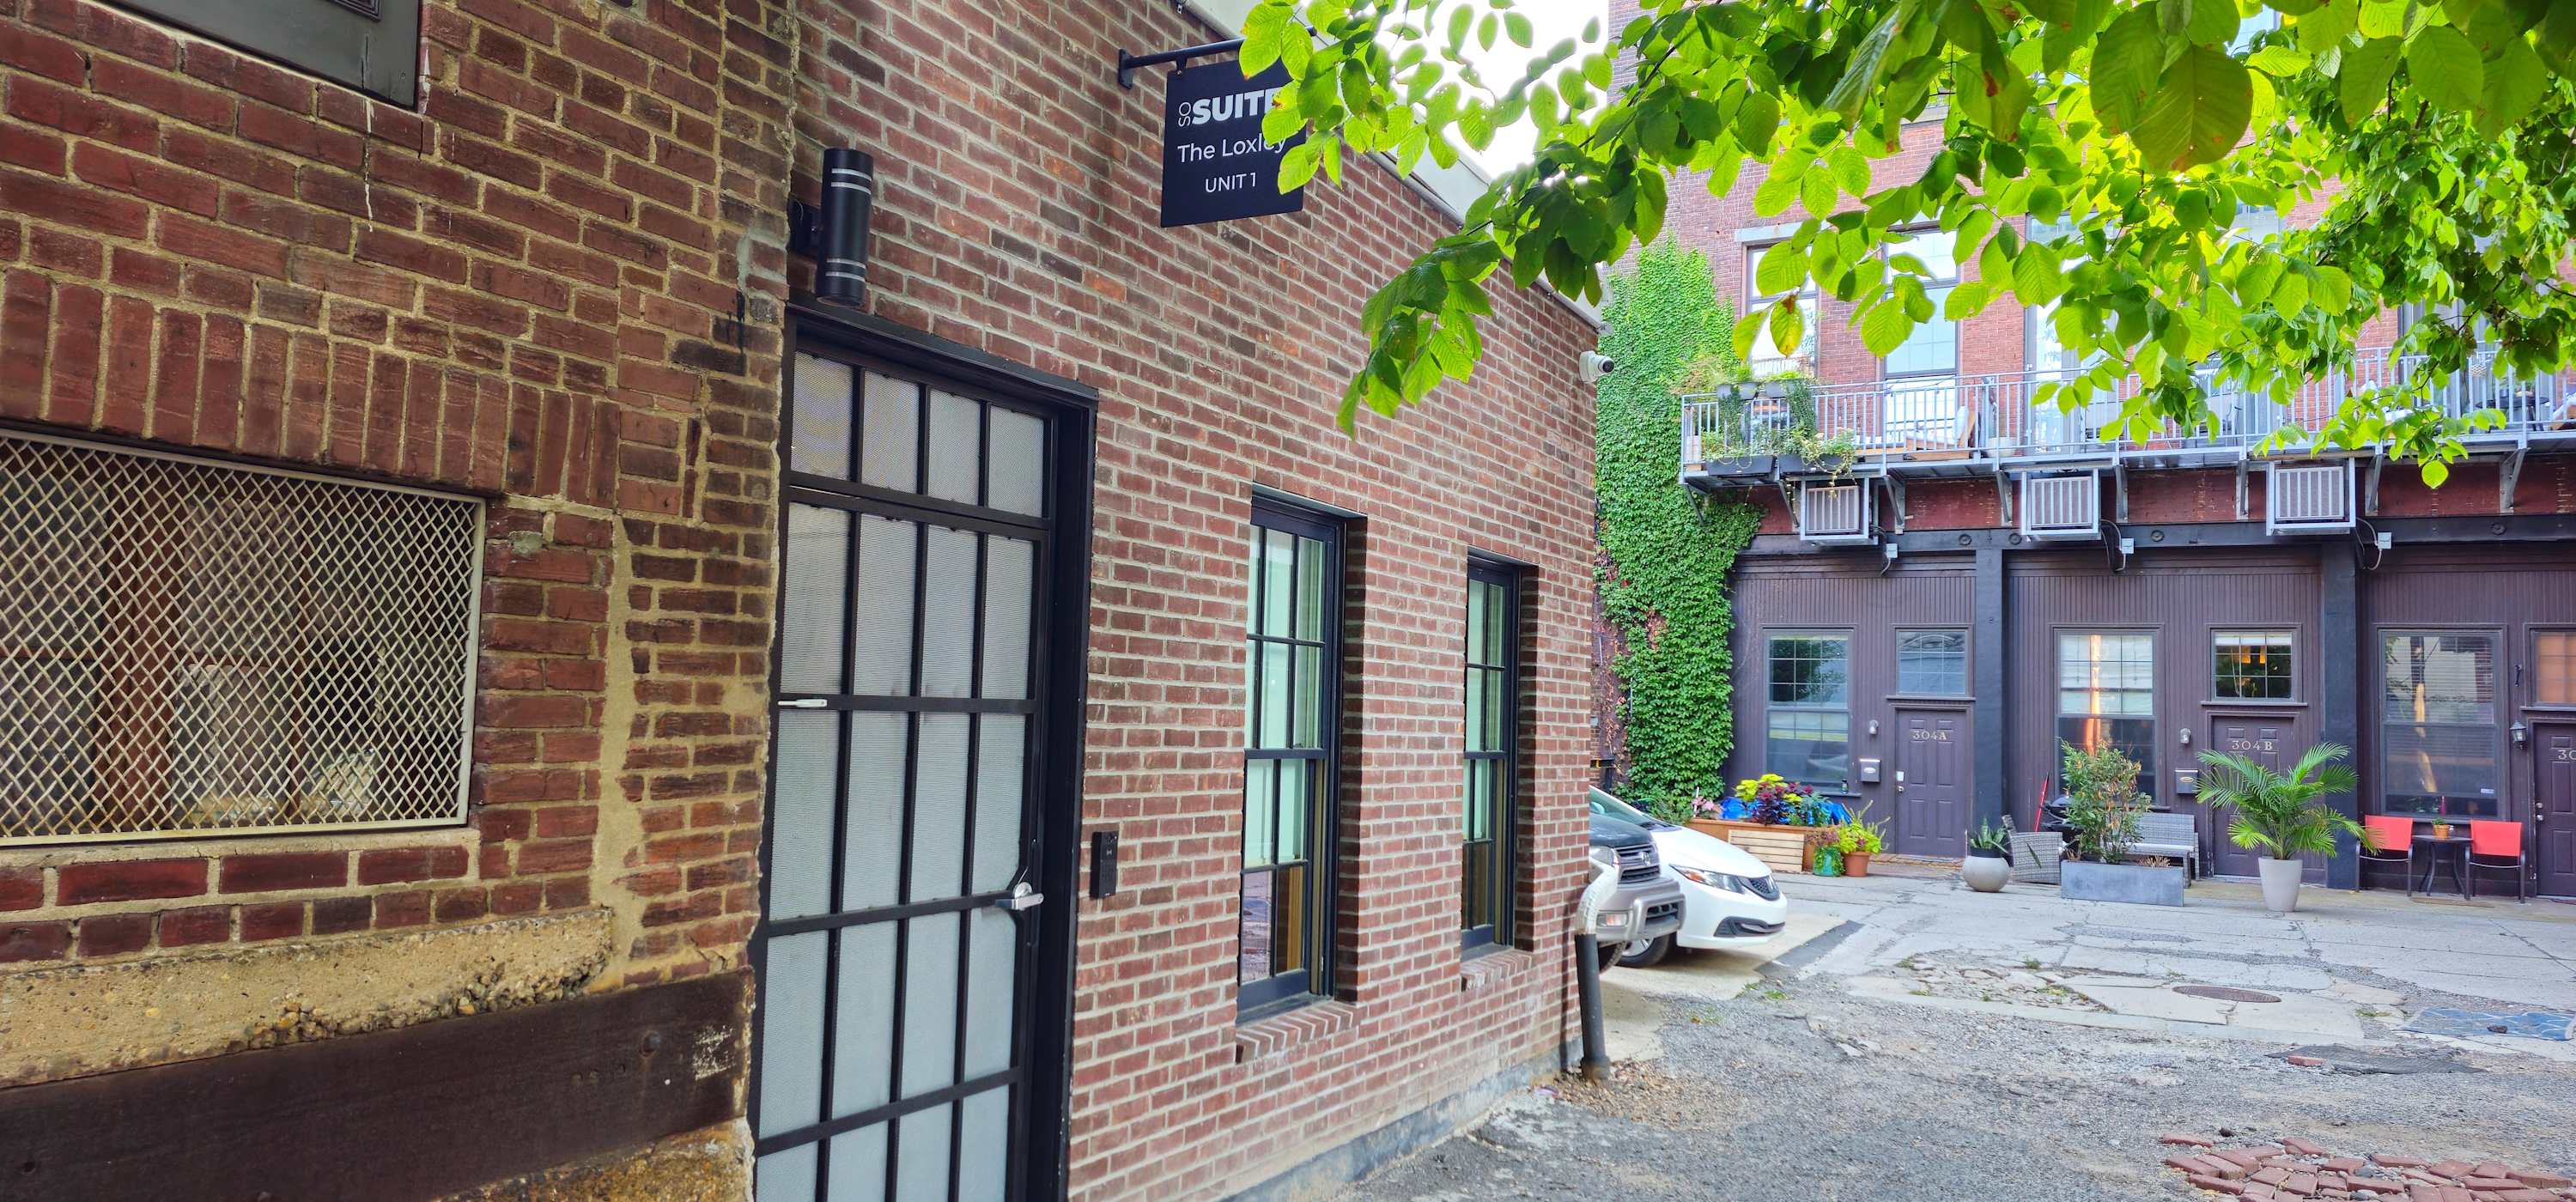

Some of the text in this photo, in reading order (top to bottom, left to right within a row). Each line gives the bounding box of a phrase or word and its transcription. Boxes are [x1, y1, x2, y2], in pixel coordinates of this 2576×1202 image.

[1178, 101, 1192, 127] SO
[1177, 143, 1216, 163] The
[1205, 172, 1256, 193] UNIT 1
[1912, 731, 1947, 740] 304A
